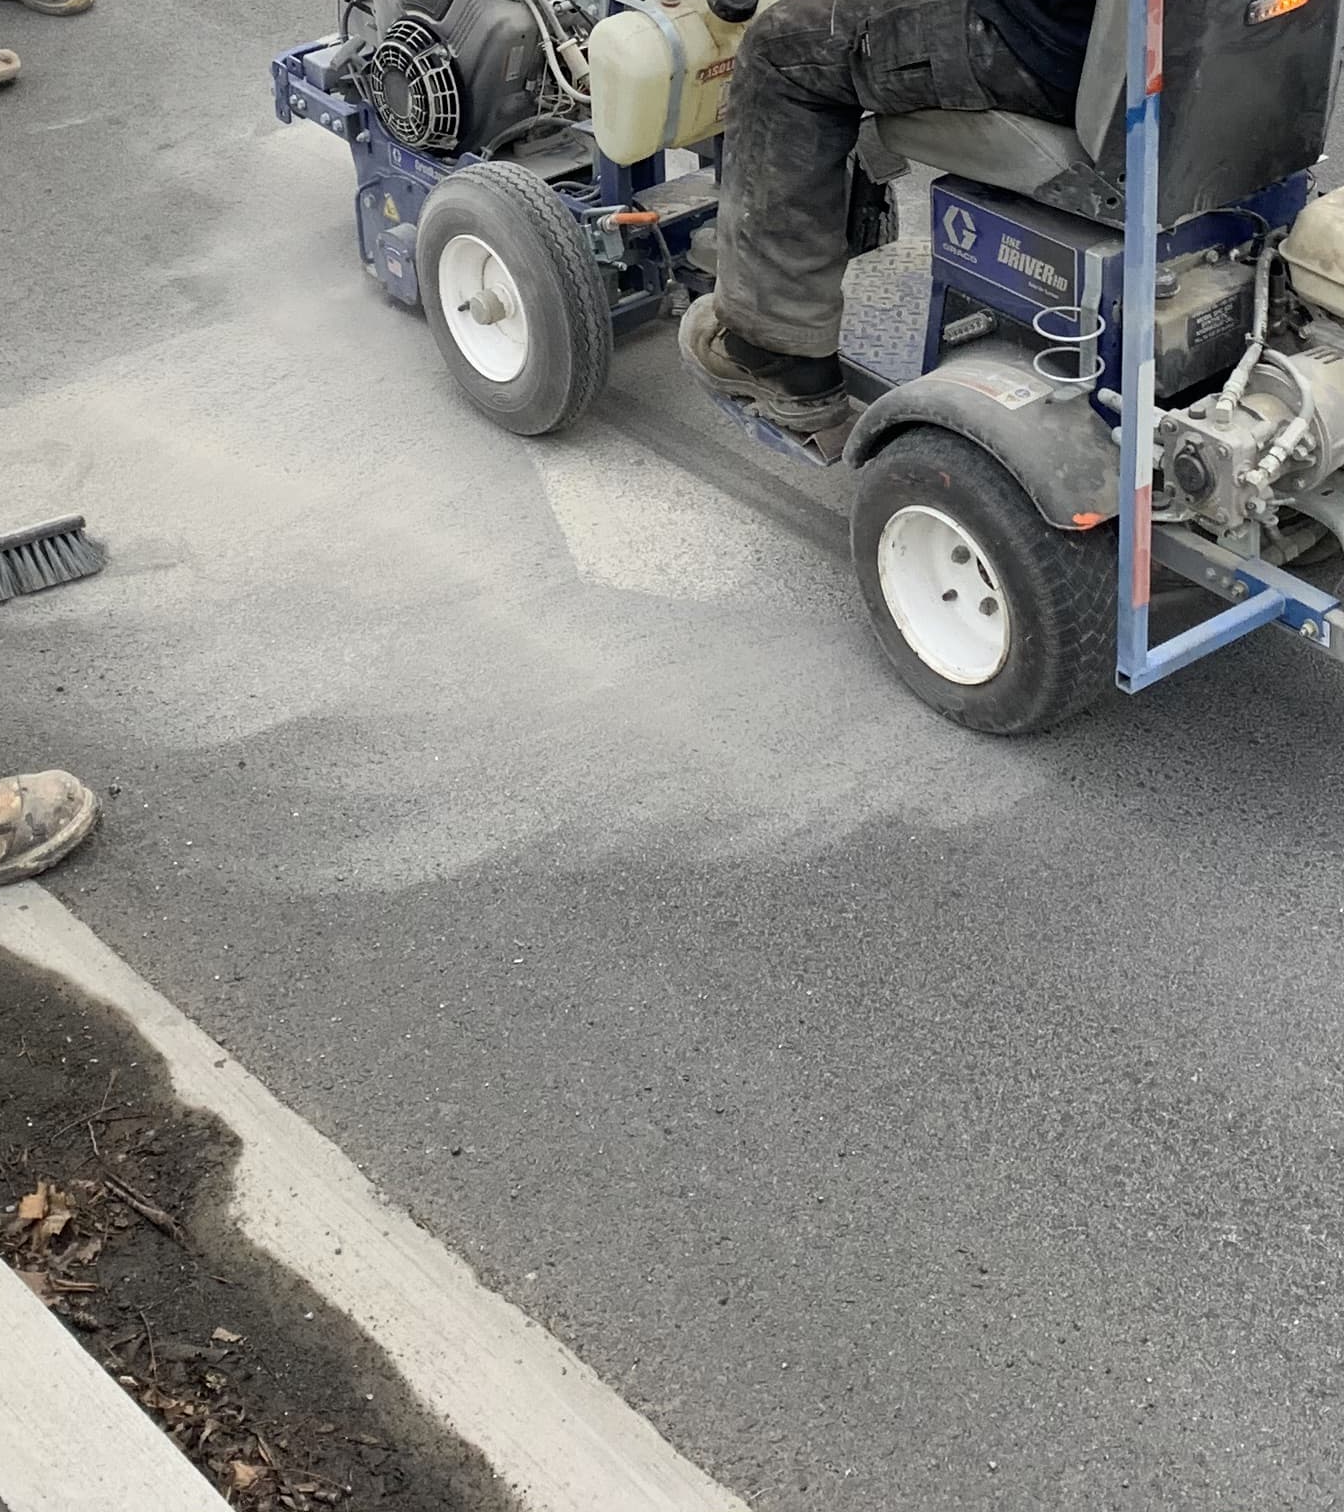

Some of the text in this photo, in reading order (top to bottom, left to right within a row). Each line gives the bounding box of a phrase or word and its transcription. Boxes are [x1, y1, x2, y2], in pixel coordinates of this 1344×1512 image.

[1000, 232, 1022, 250] LINE
[942, 242, 978, 264] GRACO
[997, 243, 1056, 287] DRIVER
